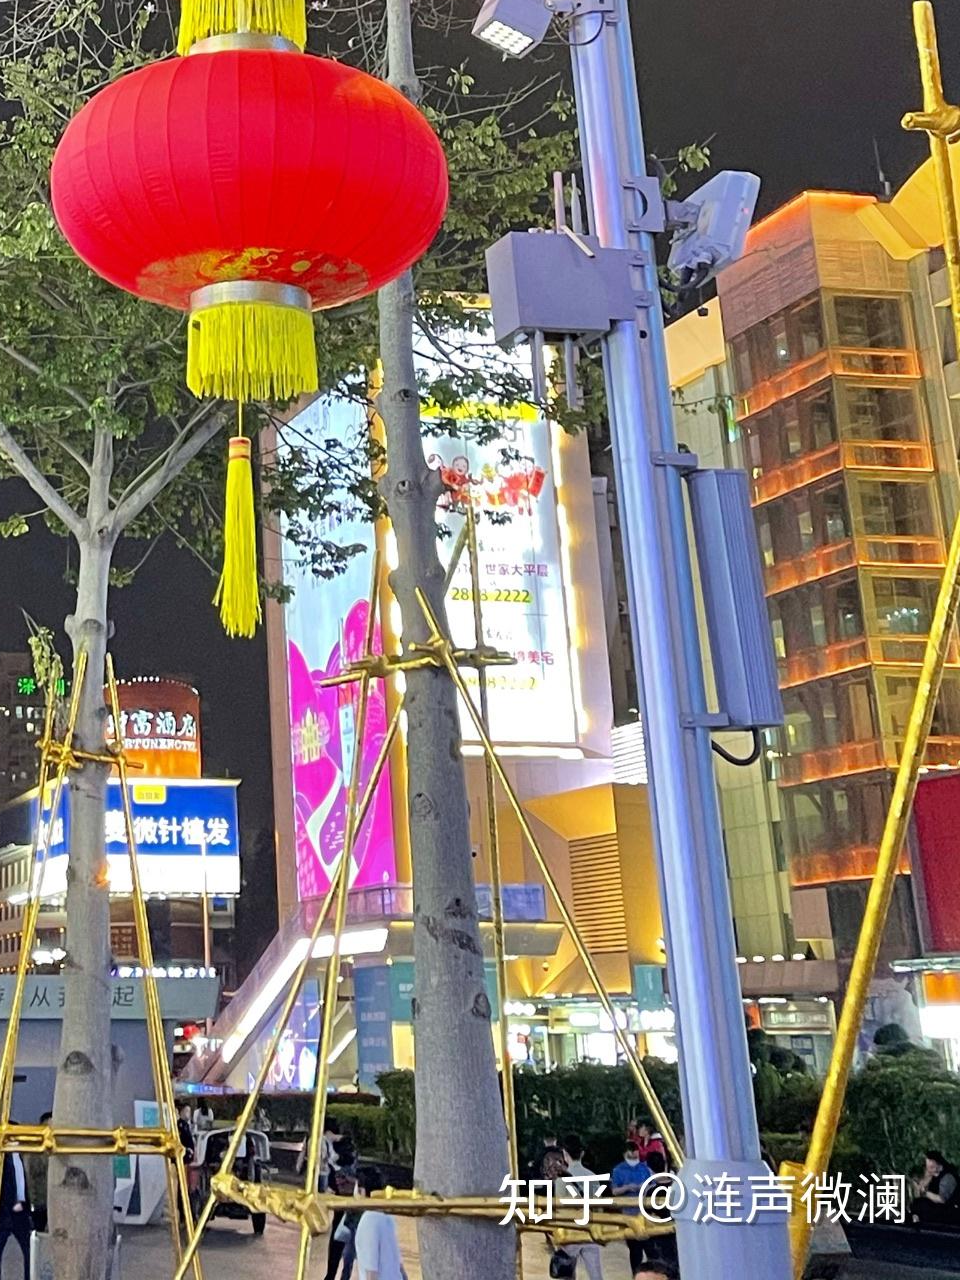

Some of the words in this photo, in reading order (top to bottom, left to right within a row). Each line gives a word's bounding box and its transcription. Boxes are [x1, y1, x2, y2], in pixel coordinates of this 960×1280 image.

[451, 587, 489, 601] 288
[494, 589, 531, 603] 2222
[29, 986, 135, 1008] 从起
